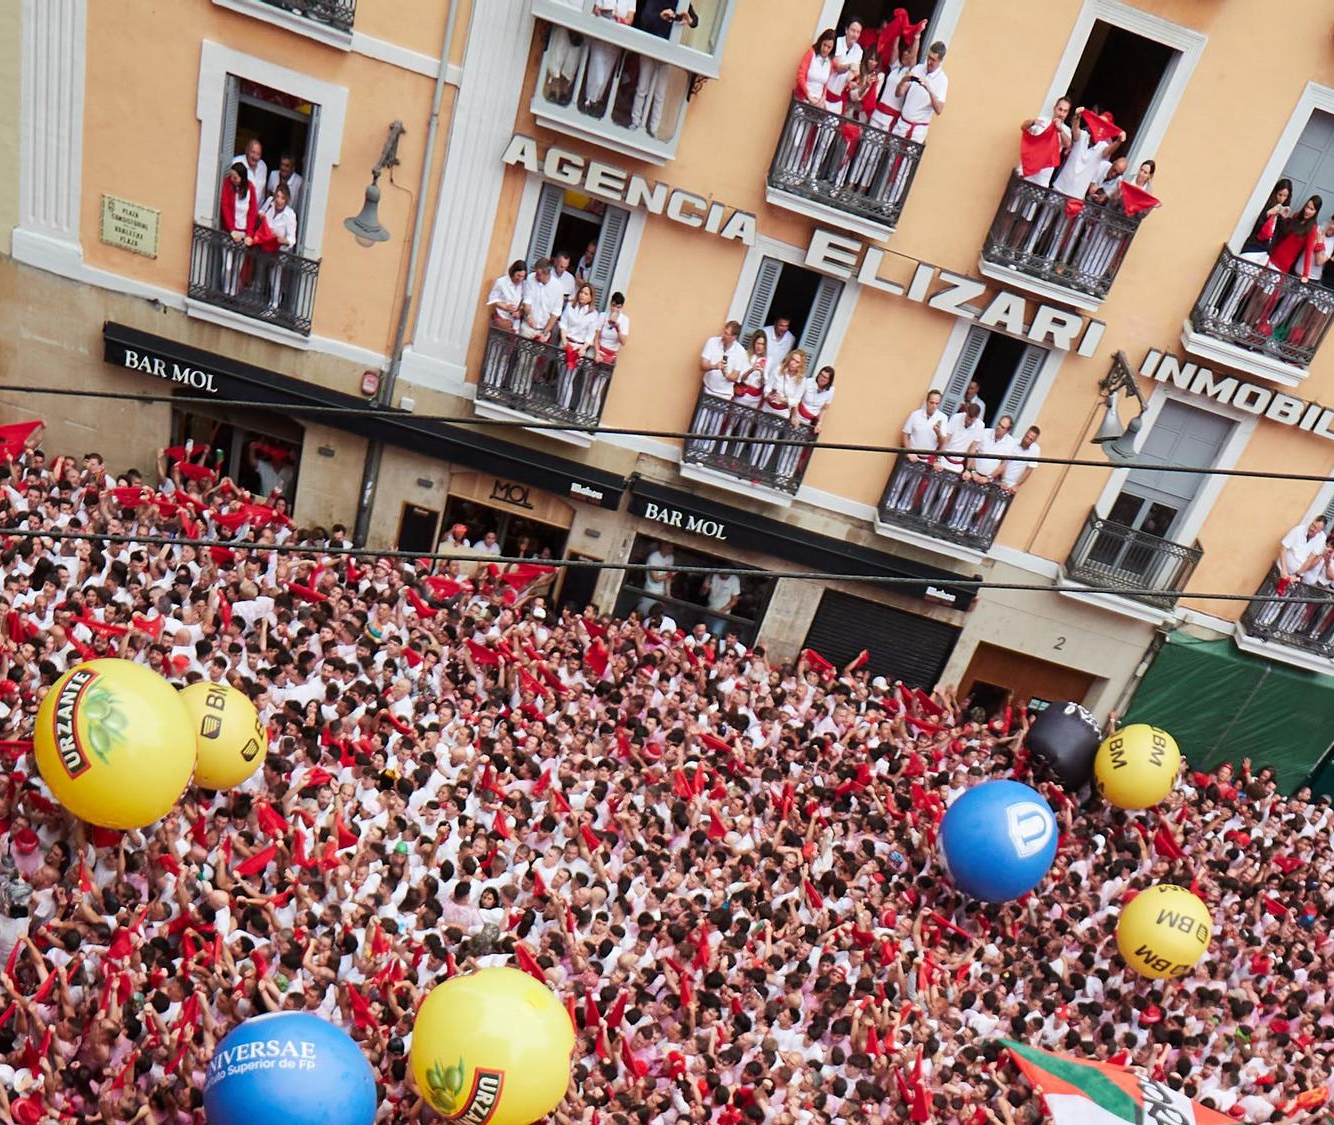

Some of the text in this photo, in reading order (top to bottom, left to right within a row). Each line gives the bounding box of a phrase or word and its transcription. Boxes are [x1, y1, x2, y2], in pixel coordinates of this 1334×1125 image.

[501, 133, 1107, 358] AGENCIA ELIZARI
[124, 350, 218, 393] BAR MOL
[490, 479, 534, 509] MOL
[644, 502, 728, 541] BAR MOL
[1053, 636, 1067, 651] 2
[57, 671, 91, 769] URZANTE
[1156, 908, 1195, 934] BM
[1134, 944, 1171, 974] BM
[210, 1039, 316, 1072] NIVERSAE
[228, 1059, 276, 1076] Superior
[278, 1059, 296, 1069] de
